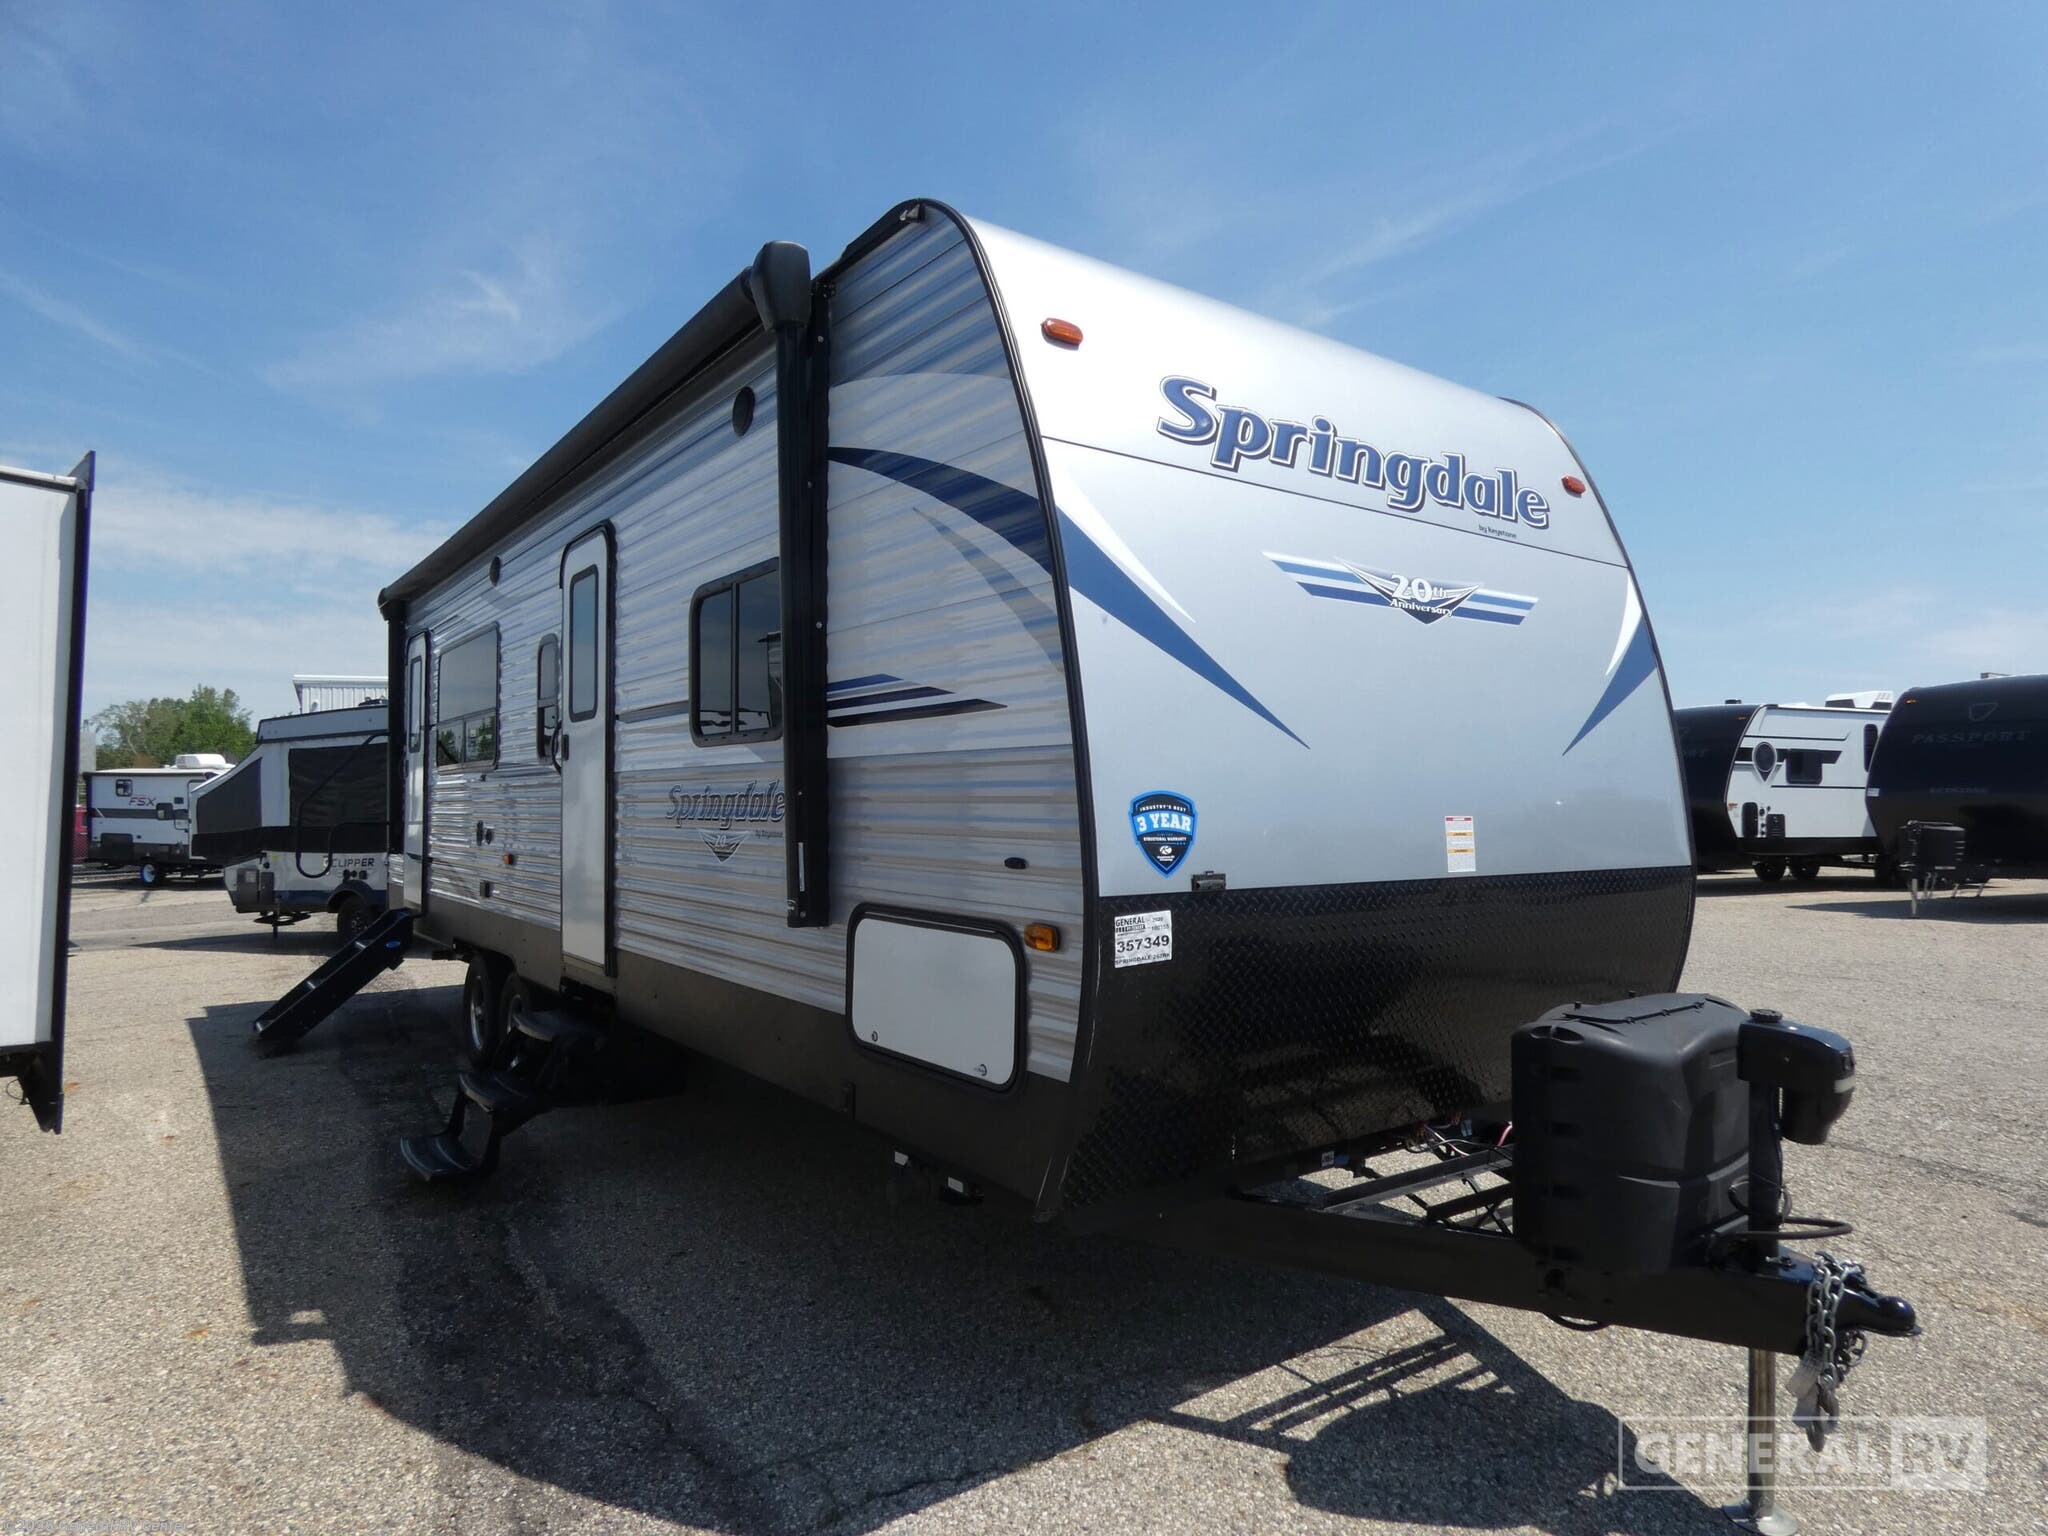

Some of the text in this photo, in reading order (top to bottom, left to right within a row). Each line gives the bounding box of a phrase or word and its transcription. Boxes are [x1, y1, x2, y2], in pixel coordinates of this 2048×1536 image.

[1157, 375, 1550, 529] Springdale
[1391, 574, 1447, 603] 20th
[1390, 599, 1453, 617] Anniversary
[1911, 730, 2031, 744] PASSPORT
[129, 796, 156, 807] FSX
[665, 779, 785, 831] Springdale
[1137, 812, 1192, 832] 3 YEAR
[331, 858, 375, 868] CLIPPER
[1115, 916, 1145, 927] GENERAL
[1116, 935, 1170, 953] 357349
